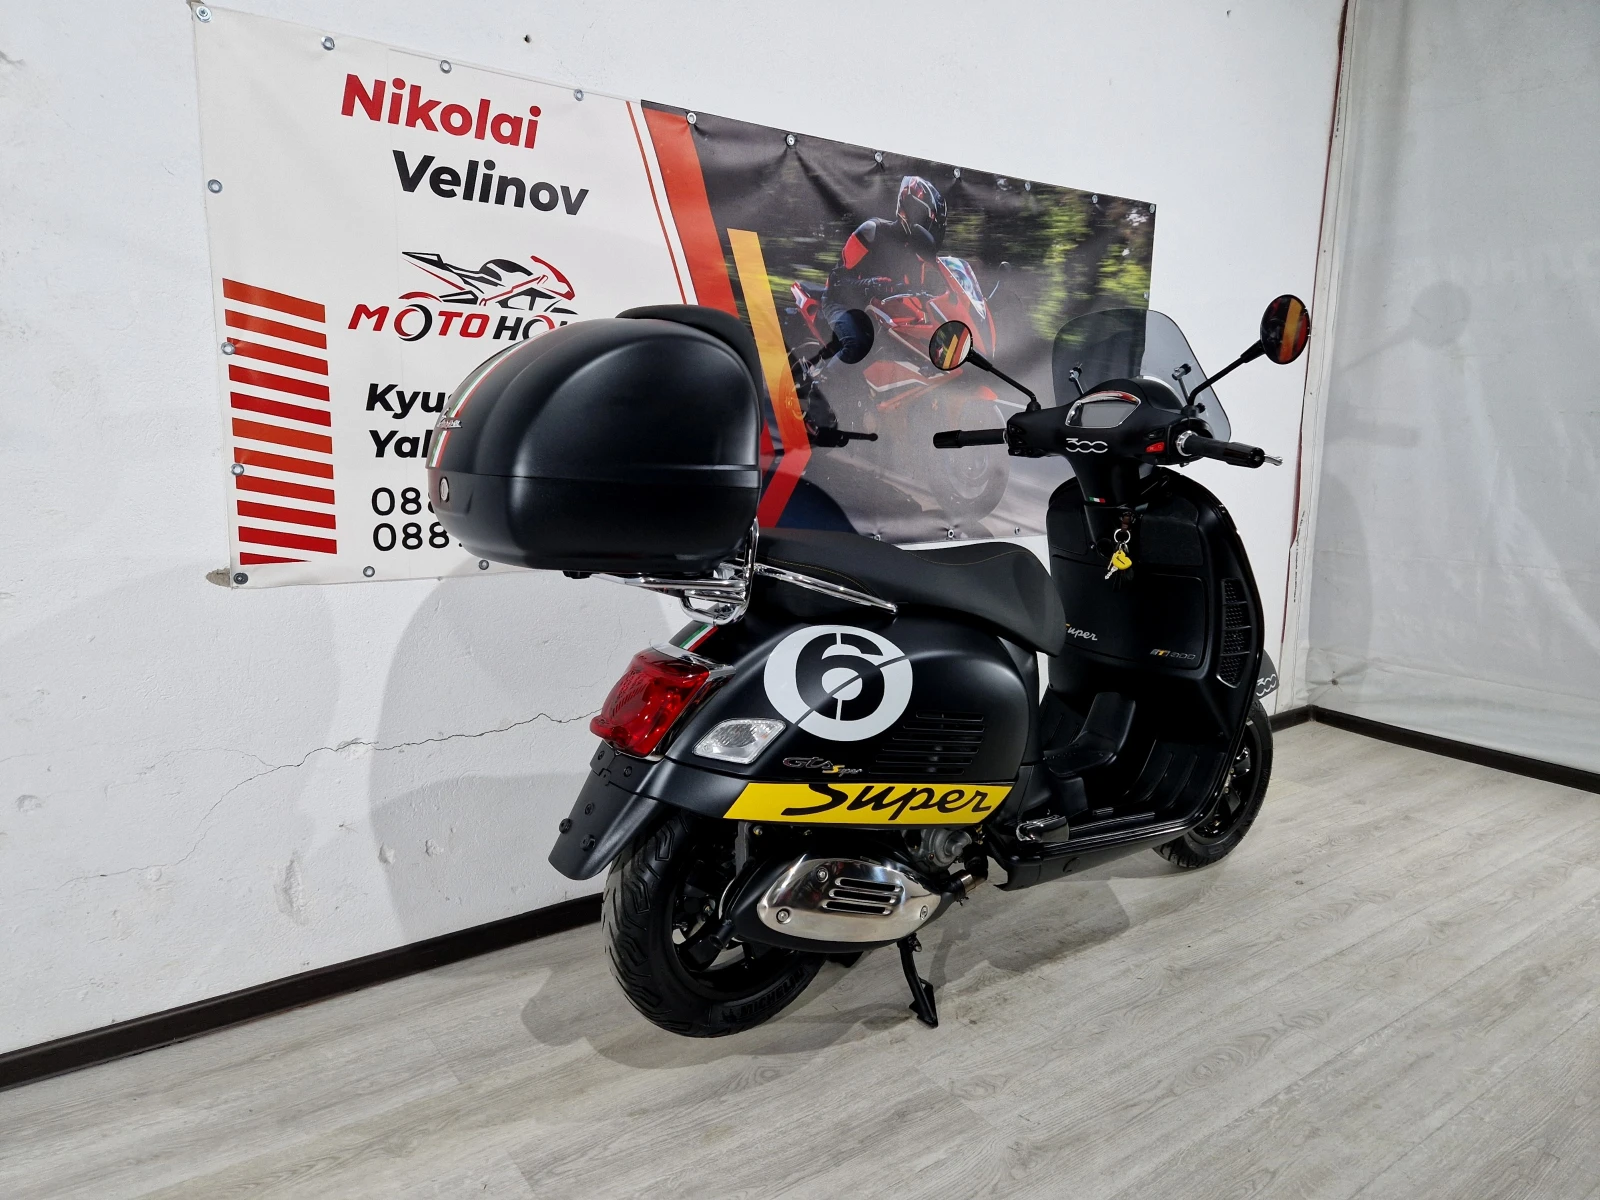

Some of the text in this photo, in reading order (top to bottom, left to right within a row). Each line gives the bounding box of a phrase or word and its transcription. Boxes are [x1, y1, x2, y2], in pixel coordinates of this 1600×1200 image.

[341, 73, 541, 149] Nikolai
[392, 149, 589, 216] Velinov
[365, 383, 452, 419] Kyu
[371, 487, 435, 516] 08
[796, 632, 885, 721] 6
[780, 783, 992, 821] Super
